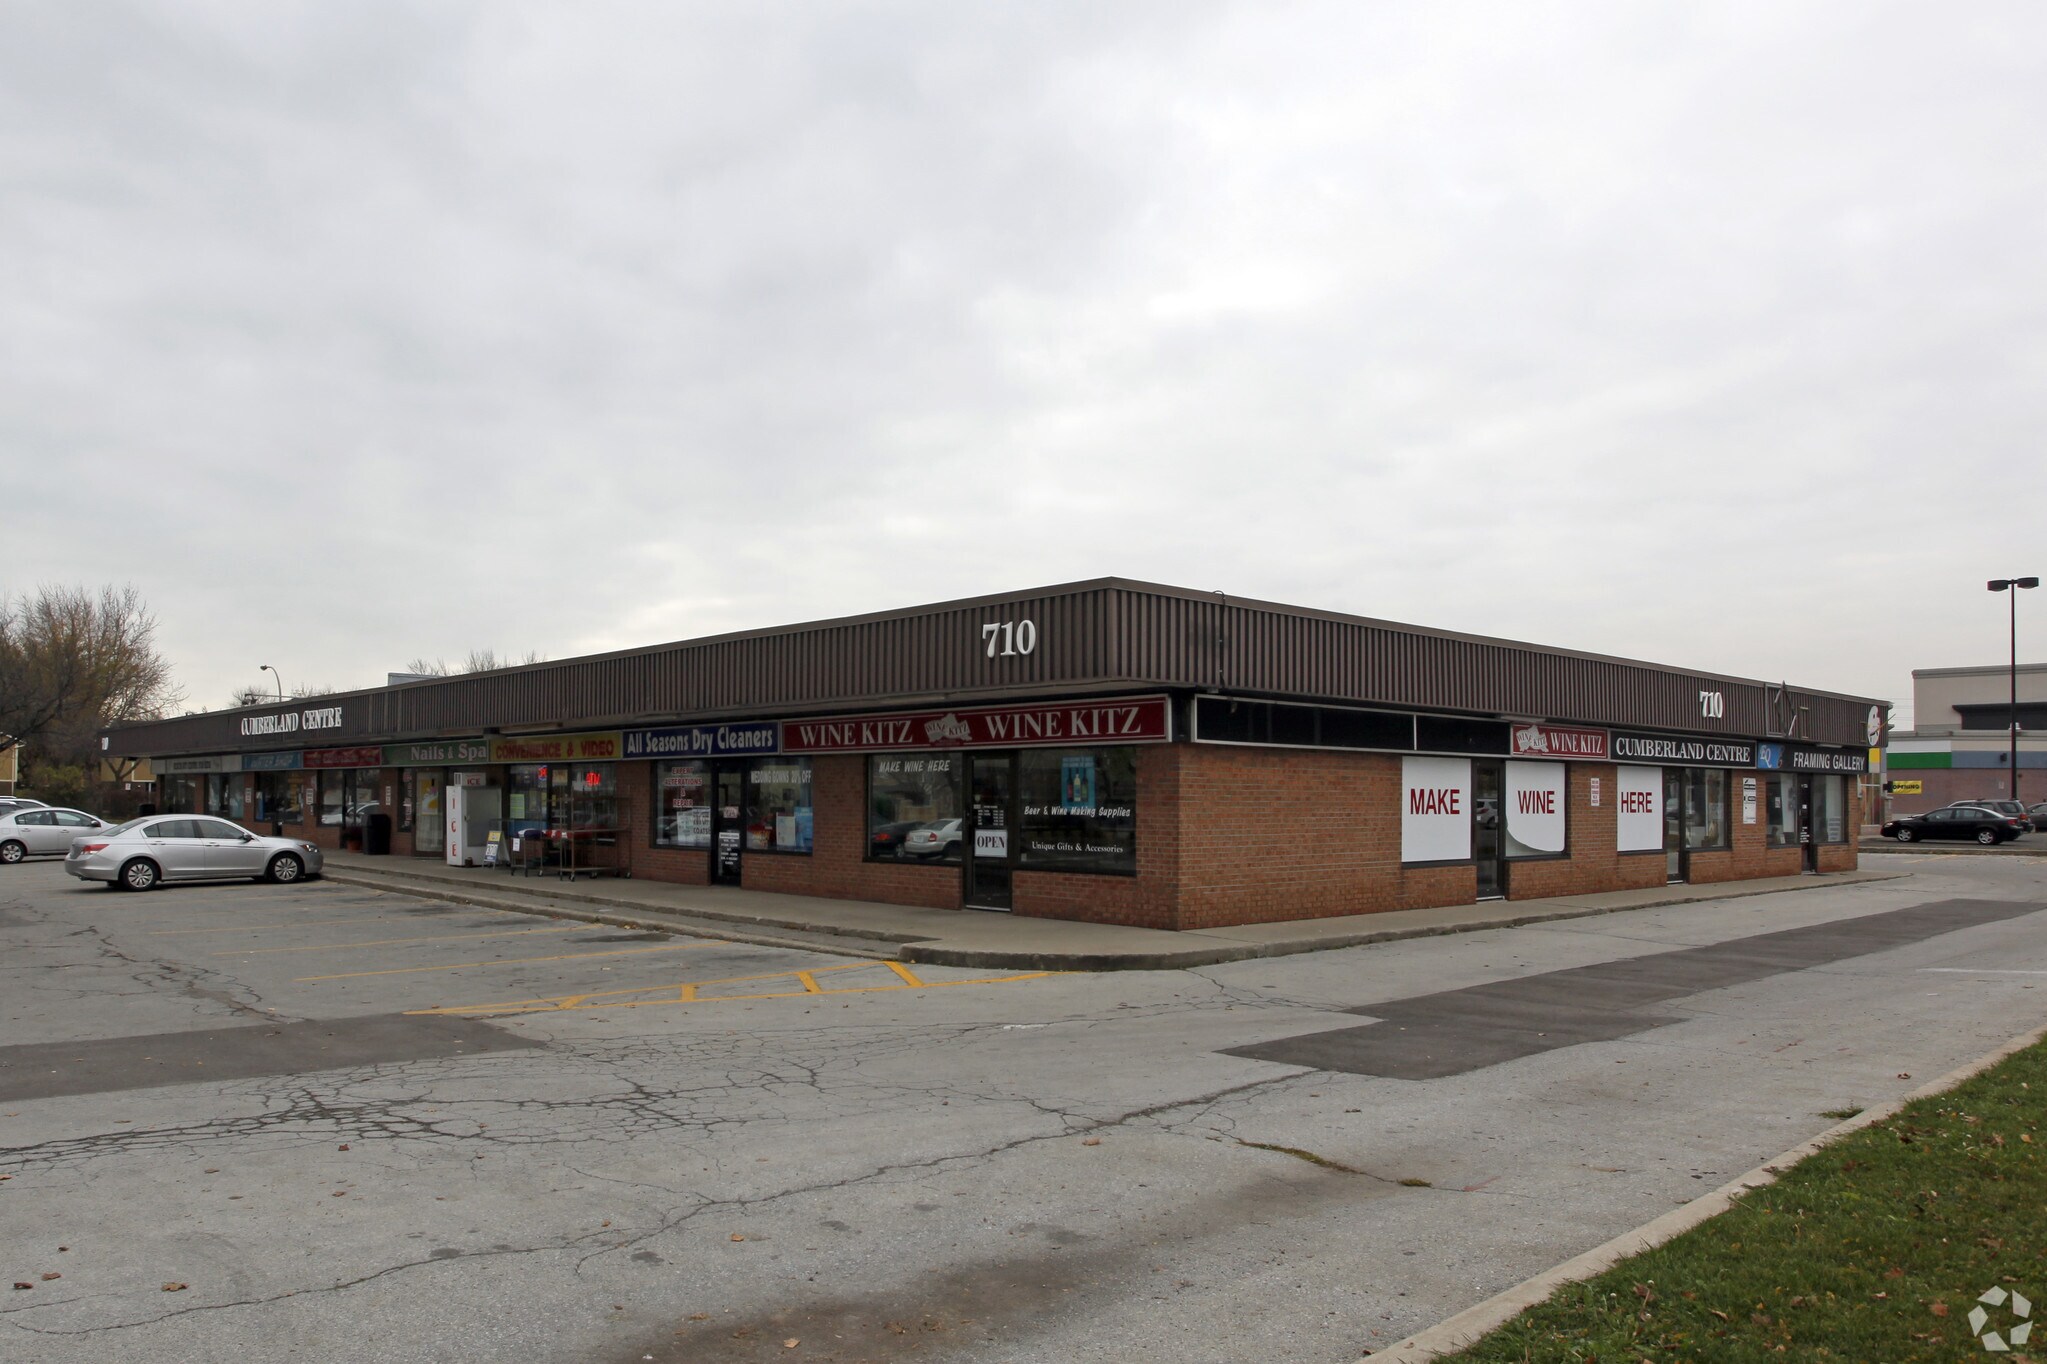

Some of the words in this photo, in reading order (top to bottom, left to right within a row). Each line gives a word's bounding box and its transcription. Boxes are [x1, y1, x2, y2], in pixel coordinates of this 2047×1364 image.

[982, 619, 1036, 657] 710
[1699, 691, 1723, 718] 710
[241, 712, 299, 736] CUMBERLAND
[302, 707, 342, 730] CENTRE
[925, 721, 947, 734] WINE
[947, 723, 969, 736] KITZ
[985, 712, 1062, 739] WINE
[1070, 706, 1141, 737] KITZ
[627, 732, 642, 754] All
[645, 731, 689, 753] Seasons
[692, 728, 713, 754] Dry
[717, 726, 773, 750] Cleaners
[799, 723, 856, 747] WINE
[861, 719, 913, 745] KITZ
[1517, 732, 1532, 742] WINE
[1533, 736, 1546, 747] KITZ
[411, 746, 444, 761] Nails
[447, 747, 454, 759] &
[458, 743, 487, 761] Spa
[496, 742, 561, 759] CONVENIENCE
[566, 742, 575, 756] &
[580, 740, 614, 756] VIDEO
[1550, 732, 1578, 752] WINE
[1580, 734, 1603, 754] KITZ
[1616, 737, 1704, 760] CUMBERLAND
[1706, 743, 1750, 763] CENTRE
[671, 766, 694, 775] EXPERT
[879, 761, 902, 773] MAKE
[904, 760, 923, 773] WINE
[927, 759, 951, 772] HERE
[1793, 752, 1830, 769] FRAMING
[1833, 753, 1866, 771] GALLERY
[663, 777, 703, 786] ALTERATIONS
[750, 770, 771, 784] WEDDING
[772, 770, 790, 784] GOWNS
[802, 770, 812, 783] OFF
[672, 799, 694, 808] REPAIR
[1410, 788, 1460, 815] MAKE
[1518, 790, 1555, 814] WINE
[1621, 791, 1652, 813] HERE
[1024, 806, 1041, 815] Beer
[1043, 806, 1048, 815] &
[1051, 806, 1068, 815] Wine
[1070, 806, 1096, 818] Making
[1098, 806, 1131, 818] Supplies
[977, 835, 1005, 849] OPEN
[1032, 841, 1055, 852] Unique
[1057, 842, 1073, 851] Gifts
[1075, 843, 1082, 852] &
[1085, 843, 1123, 854] Accessories
